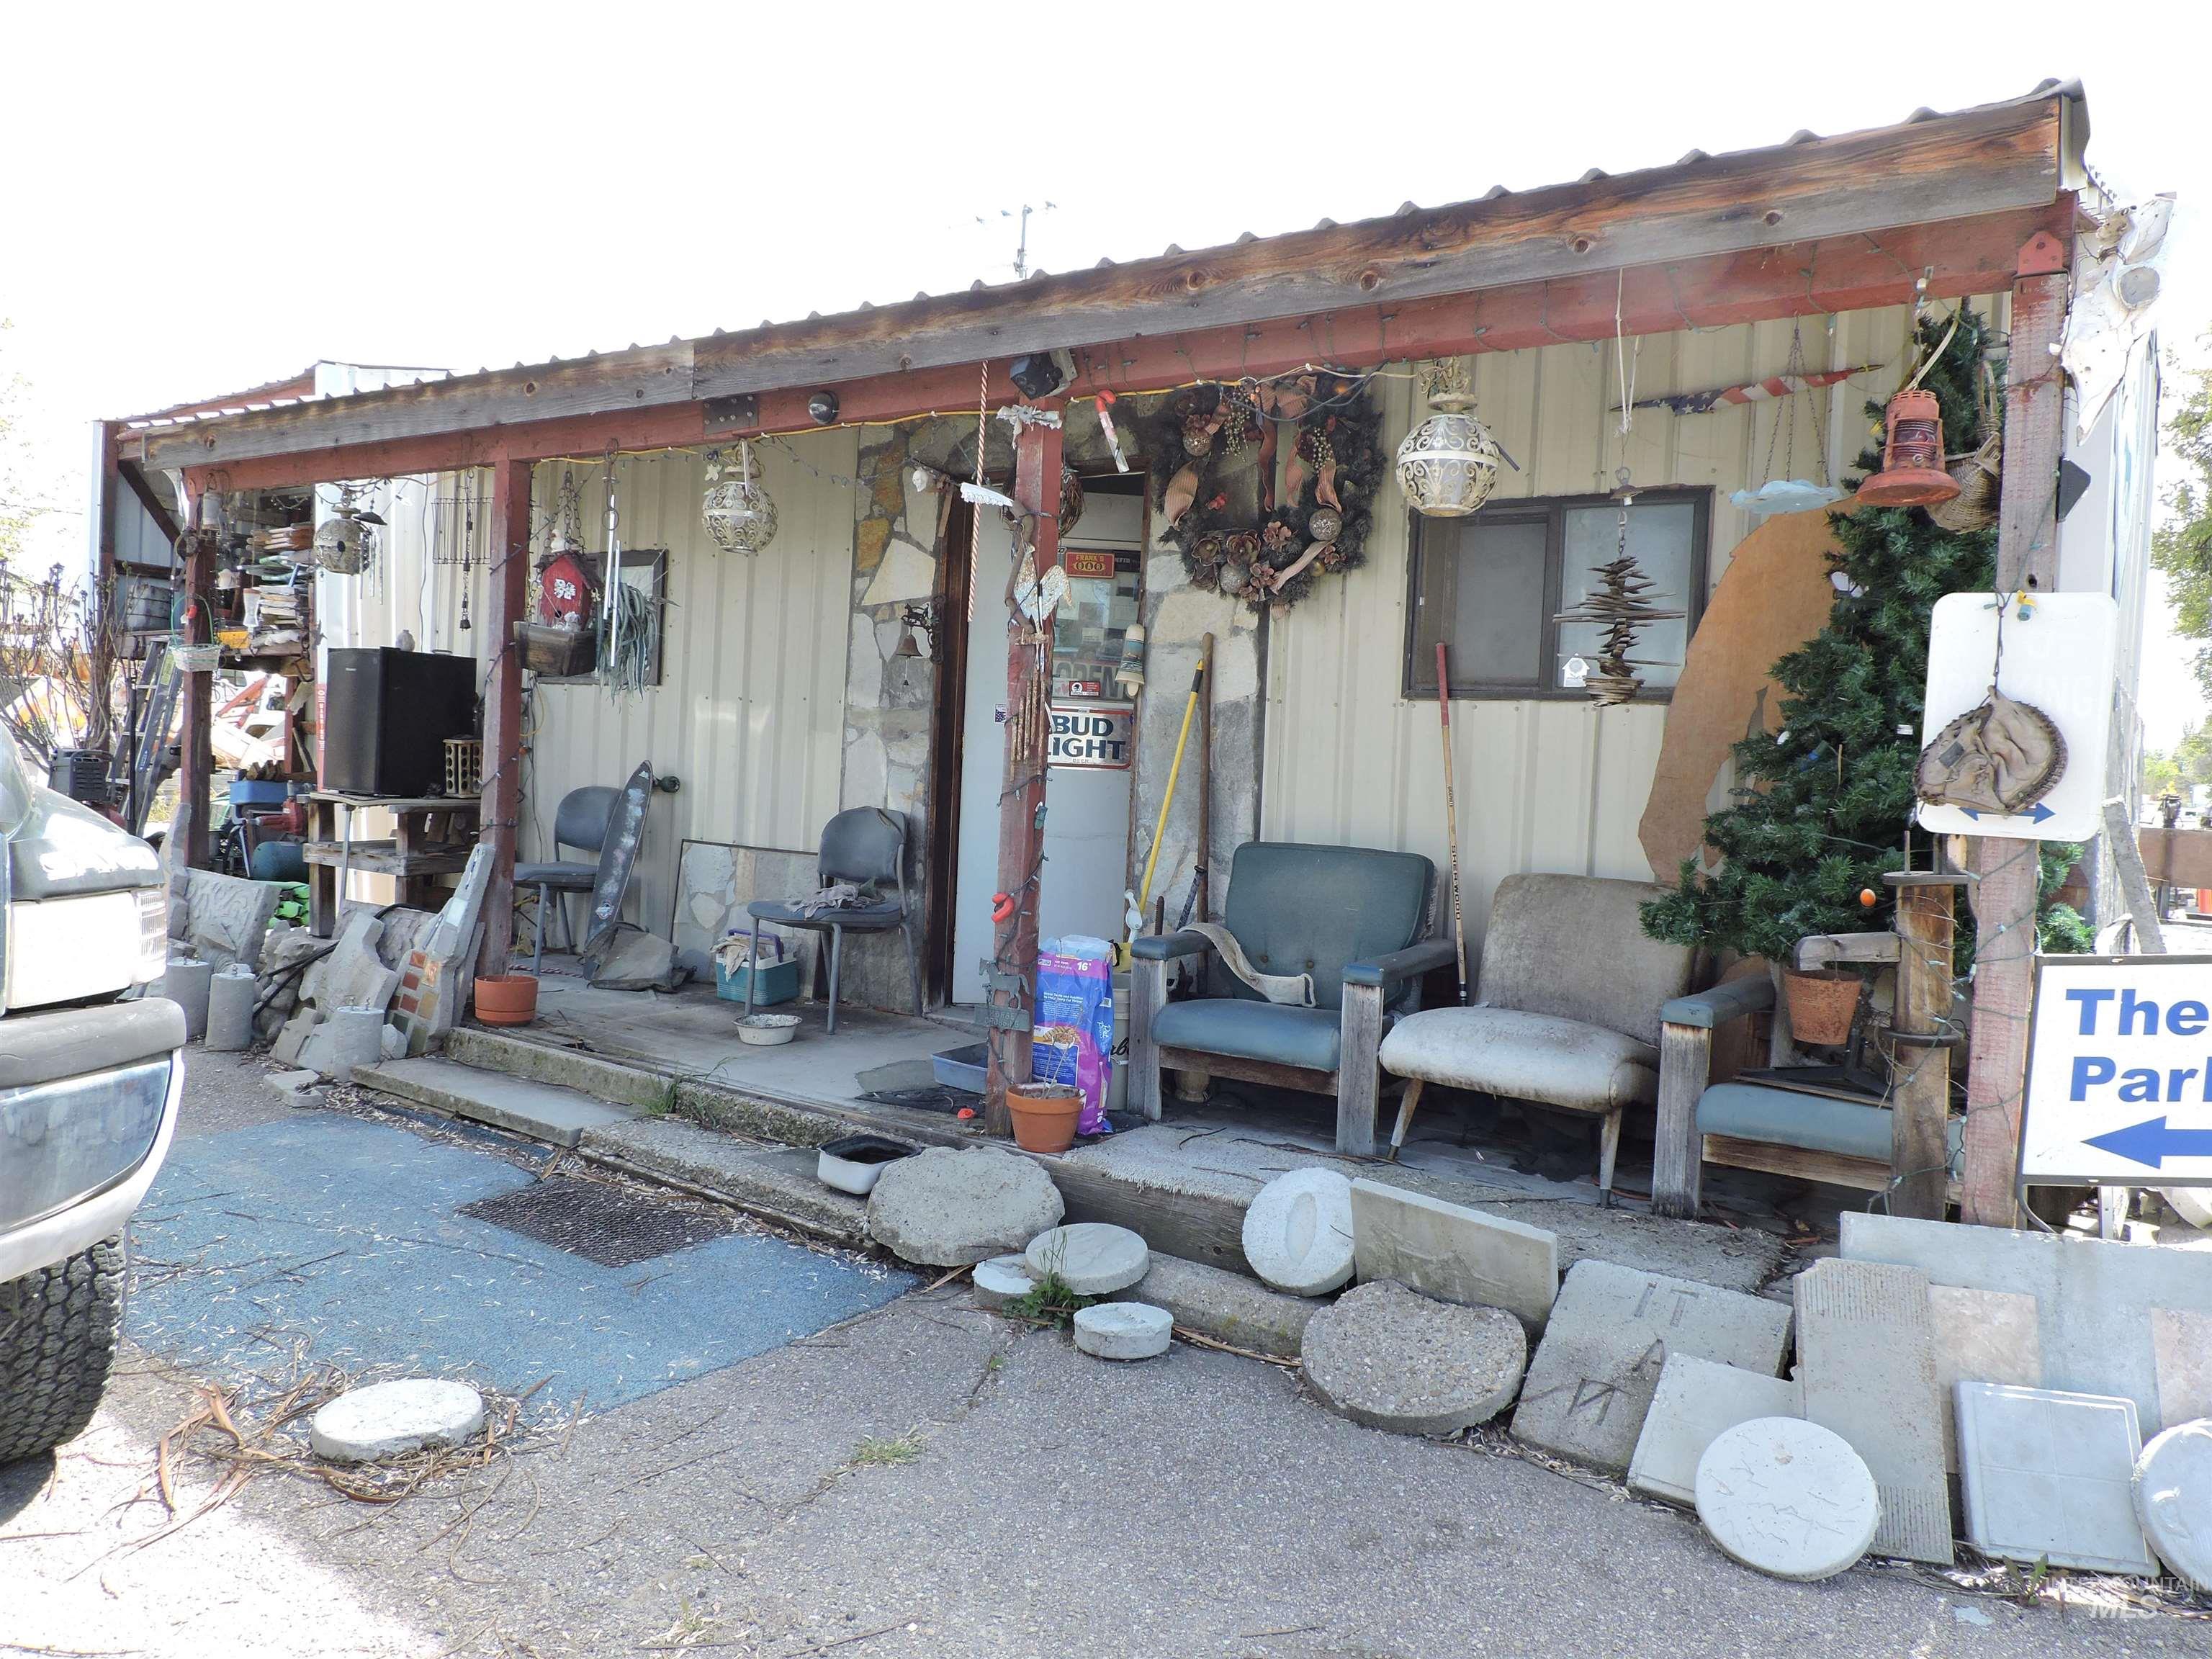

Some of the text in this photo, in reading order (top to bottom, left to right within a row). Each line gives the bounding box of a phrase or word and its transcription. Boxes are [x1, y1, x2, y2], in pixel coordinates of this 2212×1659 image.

[1076, 562, 1102, 572] BAR
[1051, 714, 1114, 737] BUD
[1048, 737, 1126, 760] IGHT
[1077, 961, 1088, 971] 16
[2065, 989, 2209, 1035] The
